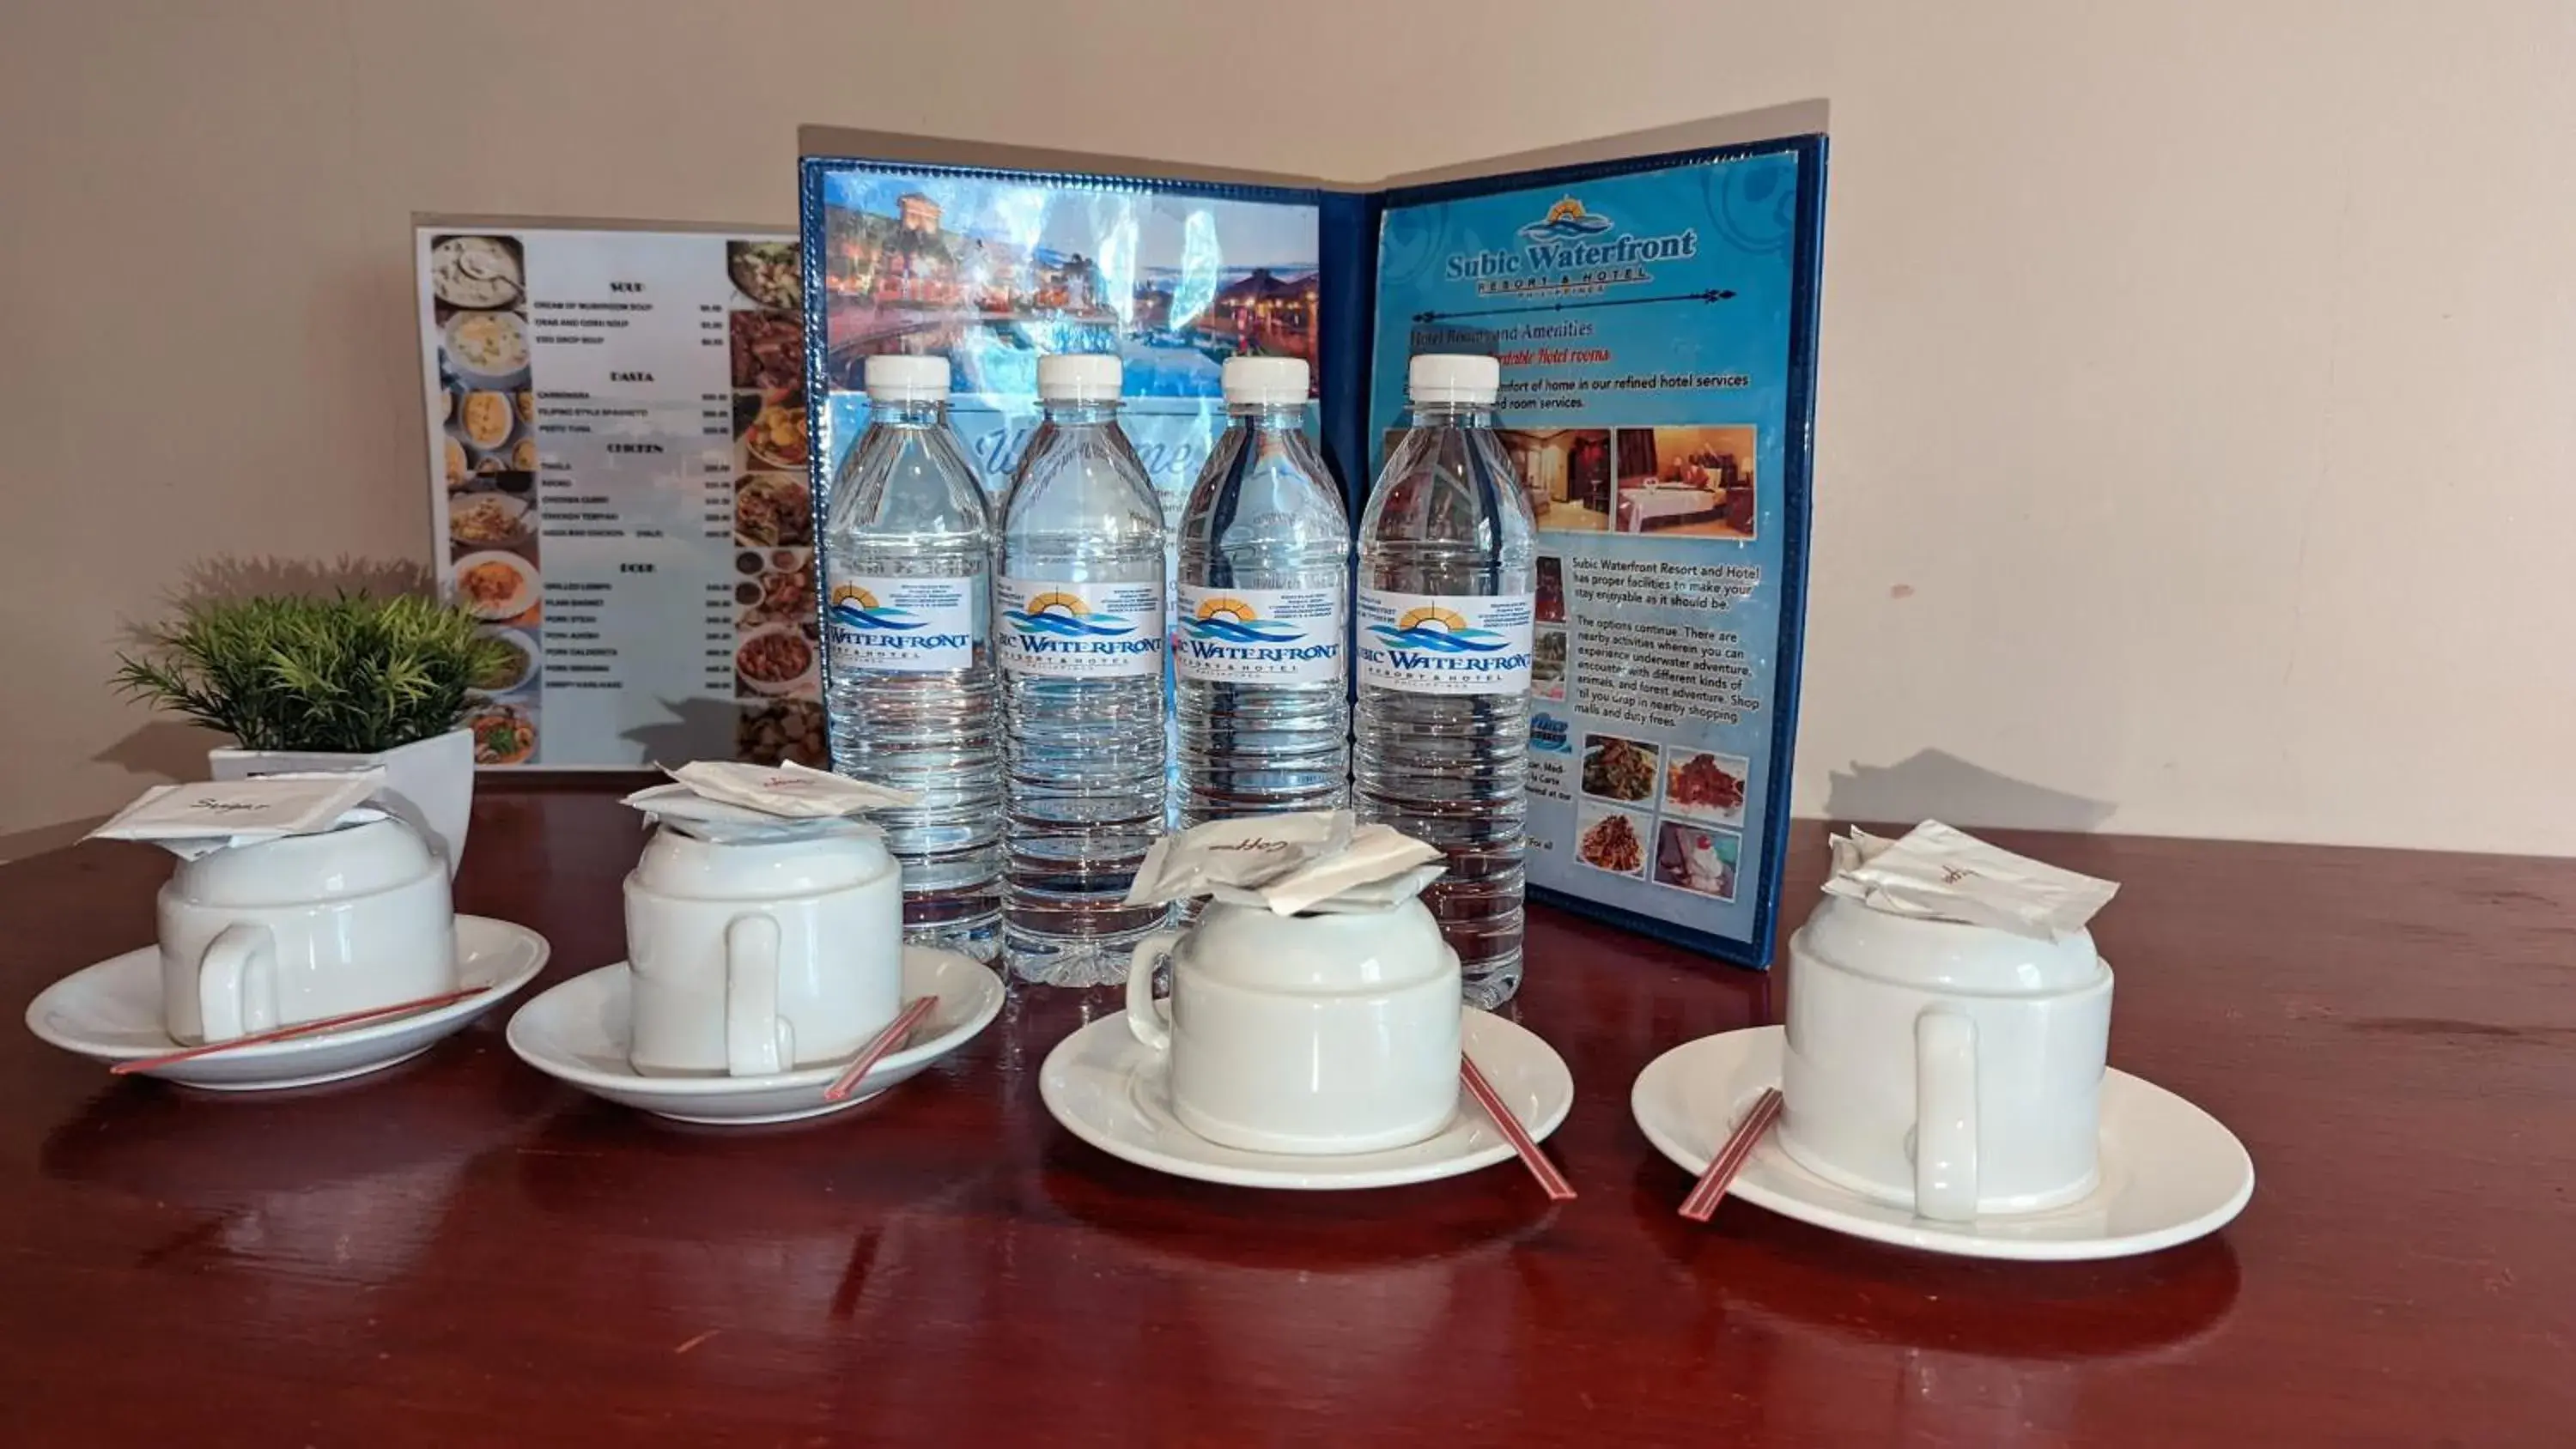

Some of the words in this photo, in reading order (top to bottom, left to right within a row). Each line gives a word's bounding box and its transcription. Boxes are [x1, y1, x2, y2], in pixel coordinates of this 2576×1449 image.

[1447, 250, 1520, 280] Subic
[1528, 230, 1695, 270] Waterfront
[1478, 276, 1547, 292] RESORT
[1562, 275, 1570, 284] &
[1583, 267, 1646, 283] HOTEL
[1522, 319, 1594, 340] Amenities
[611, 372, 654, 382] PASTA
[1531, 378, 1543, 391] of
[1546, 378, 1577, 391] home
[1578, 377, 1589, 390] in
[1592, 379, 1612, 390] our
[1614, 374, 1657, 389] refined
[1660, 374, 1693, 388] hotel
[1696, 374, 1749, 387] services
[1509, 399, 1536, 409] room
[606, 443, 664, 454] CHICKEN
[1572, 558, 1598, 570] Subic
[1600, 559, 1657, 573] Waterfront
[1660, 562, 1698, 576] Resort
[1701, 565, 1724, 578] and
[1727, 566, 1759, 580] Hotel
[1574, 573, 1589, 583] has
[1592, 575, 1625, 587] proper
[1627, 577, 1671, 591] facilities
[1689, 580, 1722, 594] make
[1723, 585, 1753, 597] your
[1574, 589, 1595, 602] stay
[1596, 590, 1643, 604] enjoyable
[1646, 595, 1657, 604] as
[1660, 593, 1668, 605] it
[1671, 595, 1709, 609] should
[1711, 598, 1730, 610] be.
[1577, 614, 1595, 627] The
[1596, 619, 1632, 633] options
[1685, 626, 1716, 641] There
[1718, 631, 1739, 644] are
[1019, 634, 1162, 655] WATERFRONT
[1189, 640, 1340, 661] WATERFRONT
[1577, 631, 1611, 646] nearby
[1613, 634, 1655, 650] activities
[1656, 640, 1698, 654] wherein
[1701, 646, 1722, 659] you
[1725, 649, 1745, 660] can
[1242, 664, 1298, 673] HOTEL
[1577, 646, 1631, 660] experience
[1632, 653, 1690, 670] underwater
[1448, 674, 1504, 682] HOTEL
[1629, 666, 1650, 679] with
[1652, 669, 1697, 686] different
[1699, 675, 1728, 691] kinds
[1730, 680, 1743, 692] of
[1619, 679, 1638, 691] and
[1640, 682, 1670, 696] forest
[1730, 694, 1760, 711] Shop
[1574, 703, 1601, 715] malls
[1602, 706, 1622, 719] and
[1624, 710, 1647, 725] duty
[1591, 691, 1610, 703] you
[1612, 692, 1636, 707] drop
[1637, 696, 1649, 708] in
[1650, 699, 1686, 716] nearby
[1688, 706, 1739, 724] shopping
